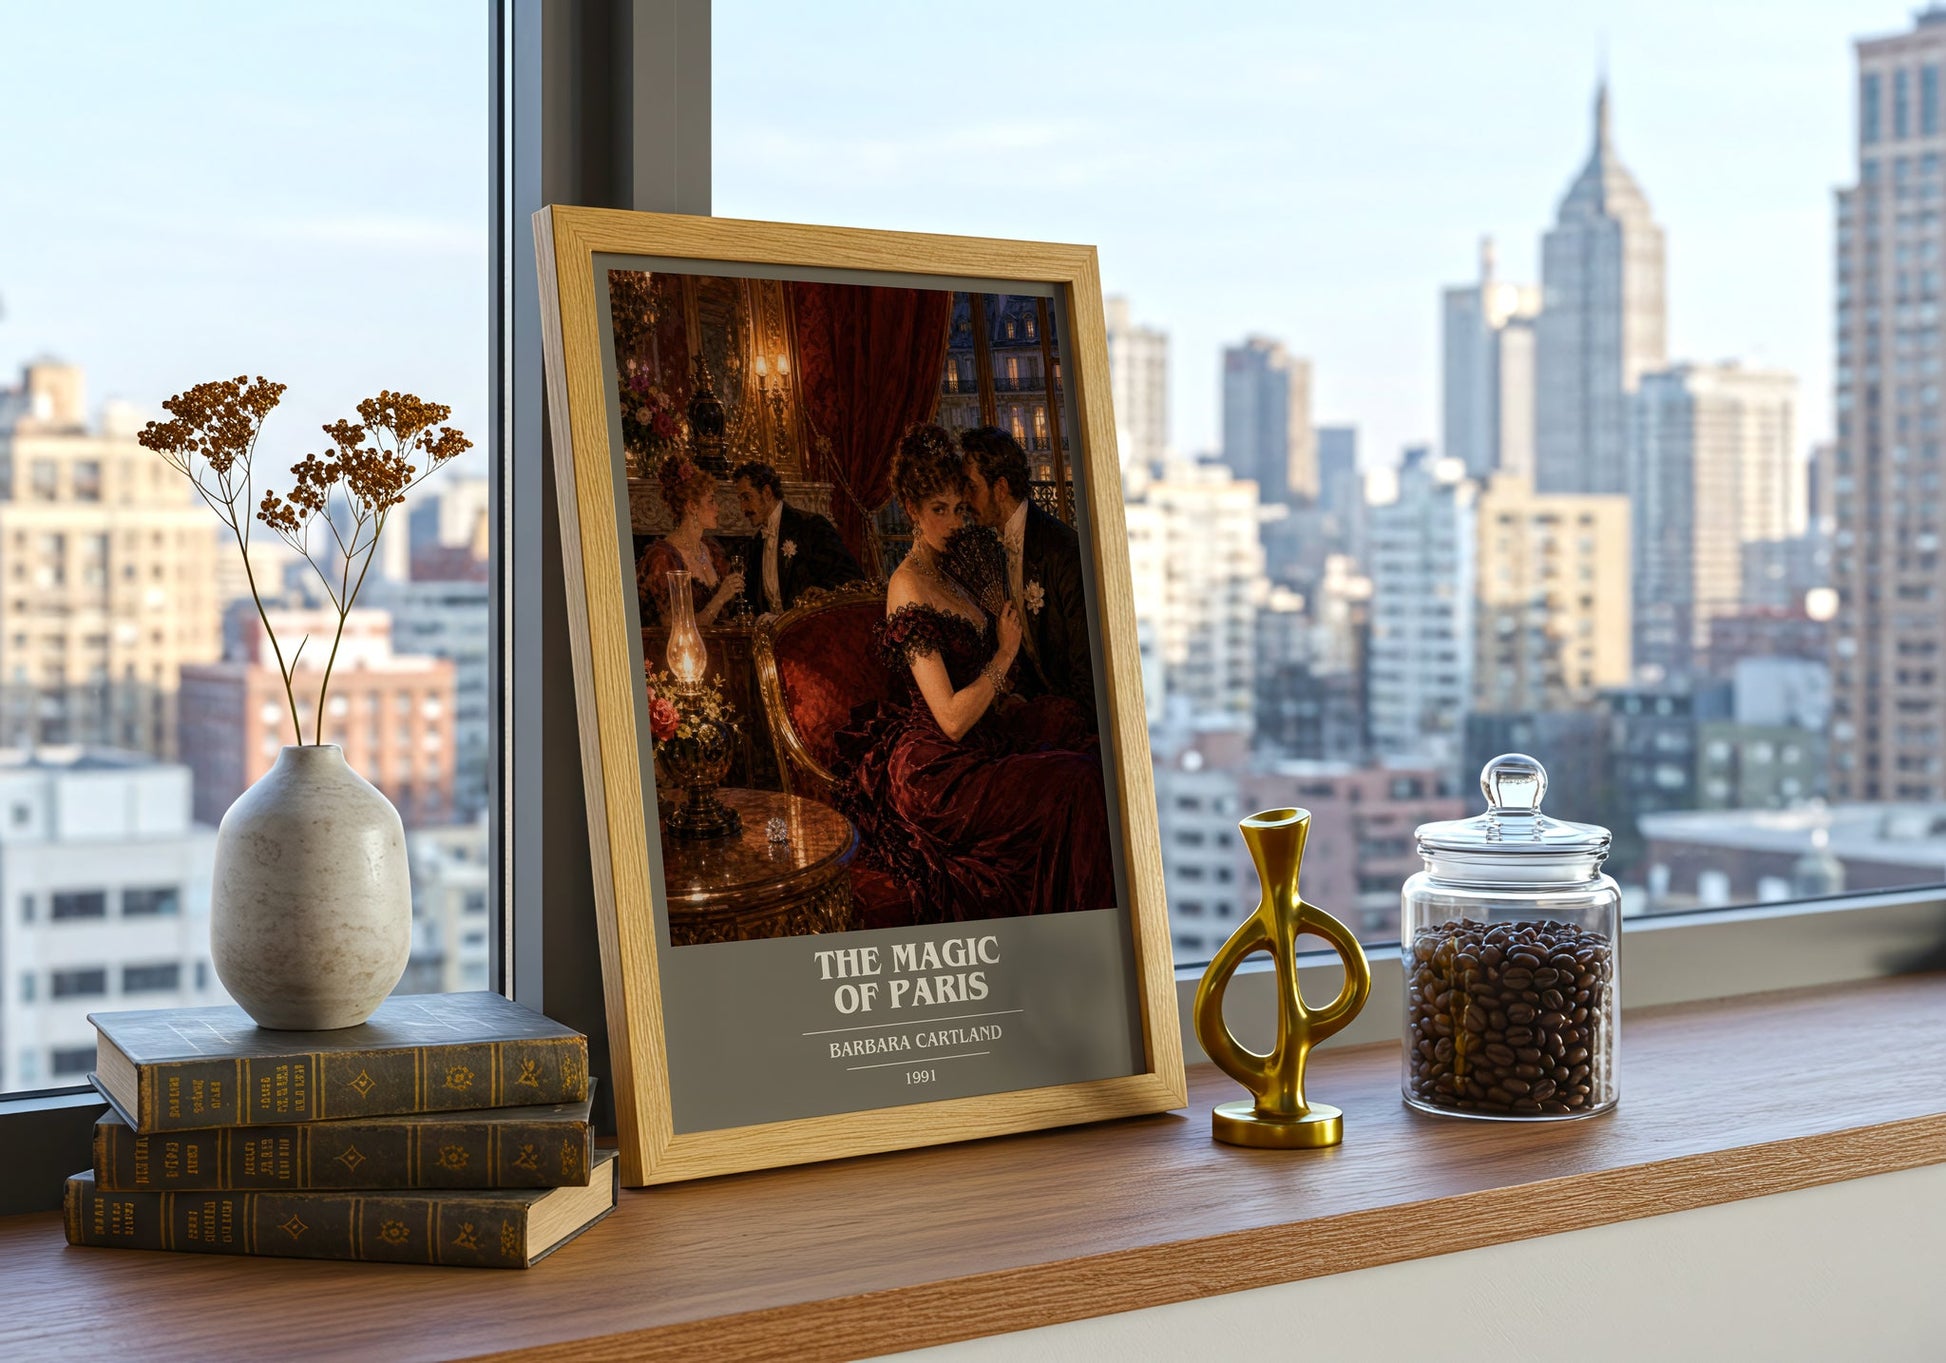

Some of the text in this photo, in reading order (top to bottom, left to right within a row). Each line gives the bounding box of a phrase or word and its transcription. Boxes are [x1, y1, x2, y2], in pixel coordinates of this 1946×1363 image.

[814, 935, 1001, 980] THE MAGIC
[834, 971, 989, 1014] OF PARIS
[829, 1024, 1003, 1058] BARBARA CARTLAND
[905, 1069, 937, 1085] 1991
